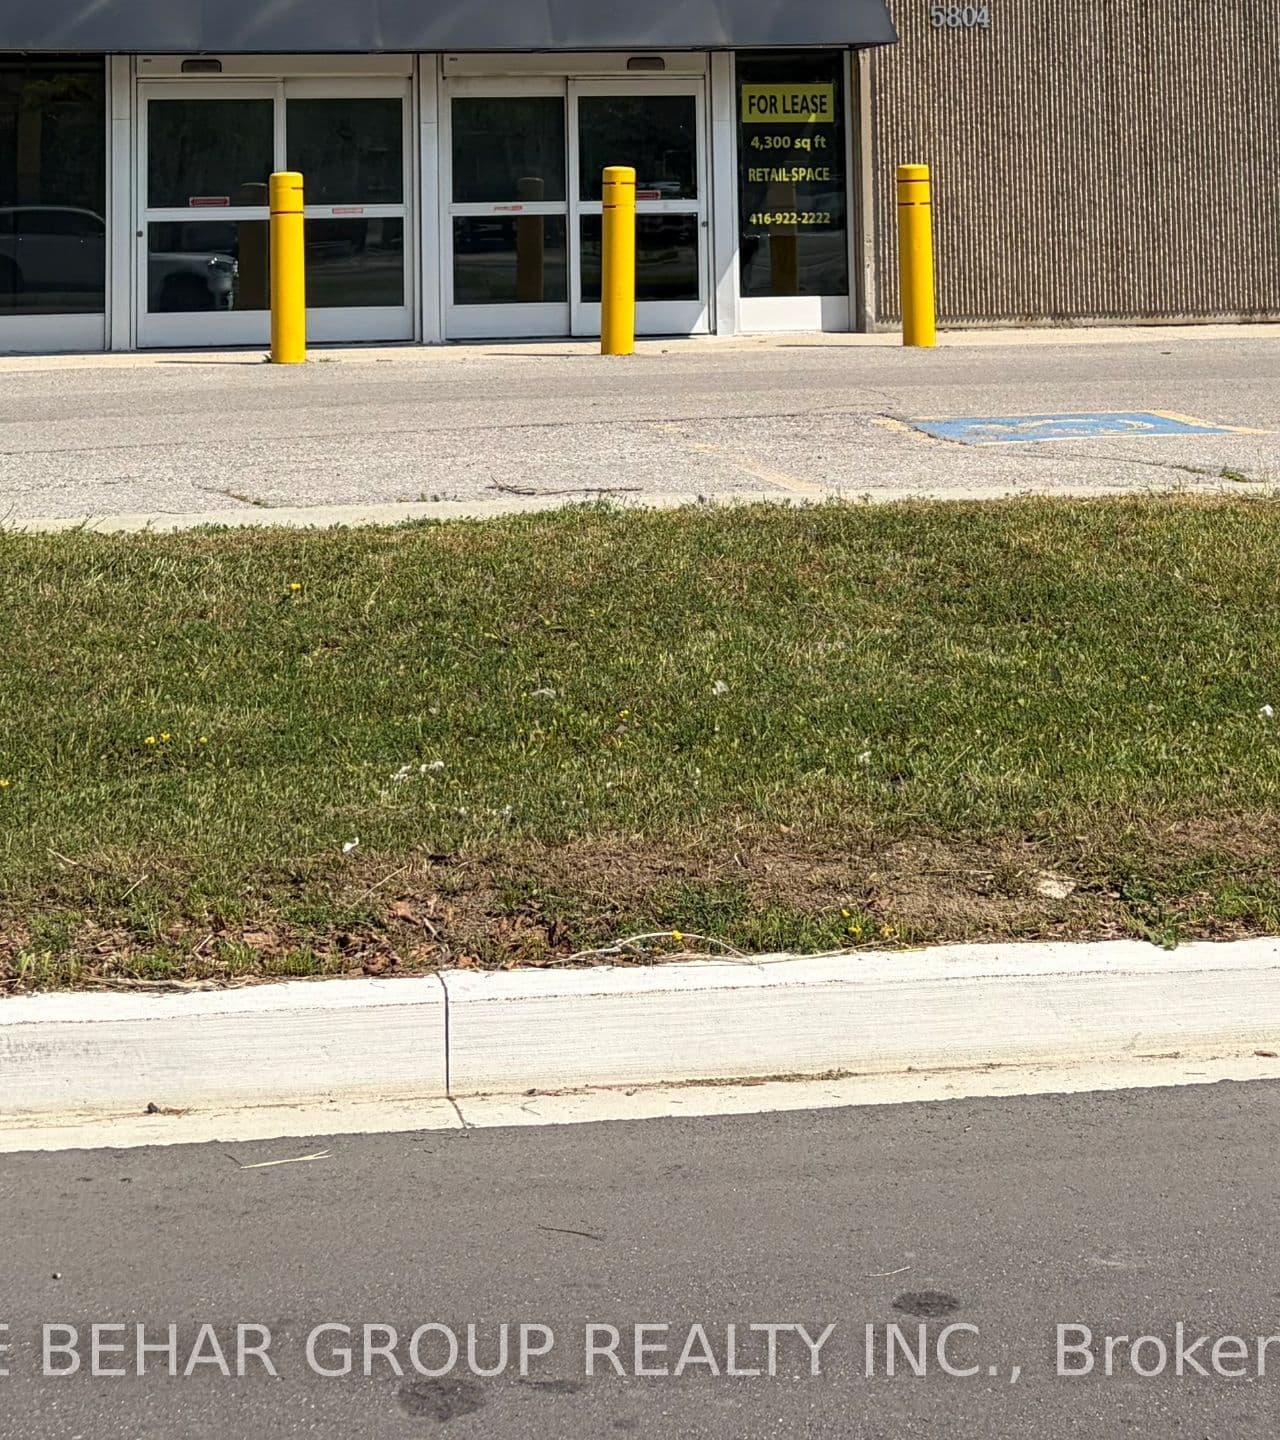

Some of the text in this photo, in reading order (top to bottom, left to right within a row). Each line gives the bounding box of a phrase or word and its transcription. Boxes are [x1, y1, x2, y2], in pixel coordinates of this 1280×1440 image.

[930, 5, 991, 28] 5804
[748, 94, 827, 114] FOR LEASE
[751, 135, 827, 152] 4,300 sq ft
[748, 167, 831, 182] RETAIL SPACE
[749, 212, 831, 225] 416-922-2222
